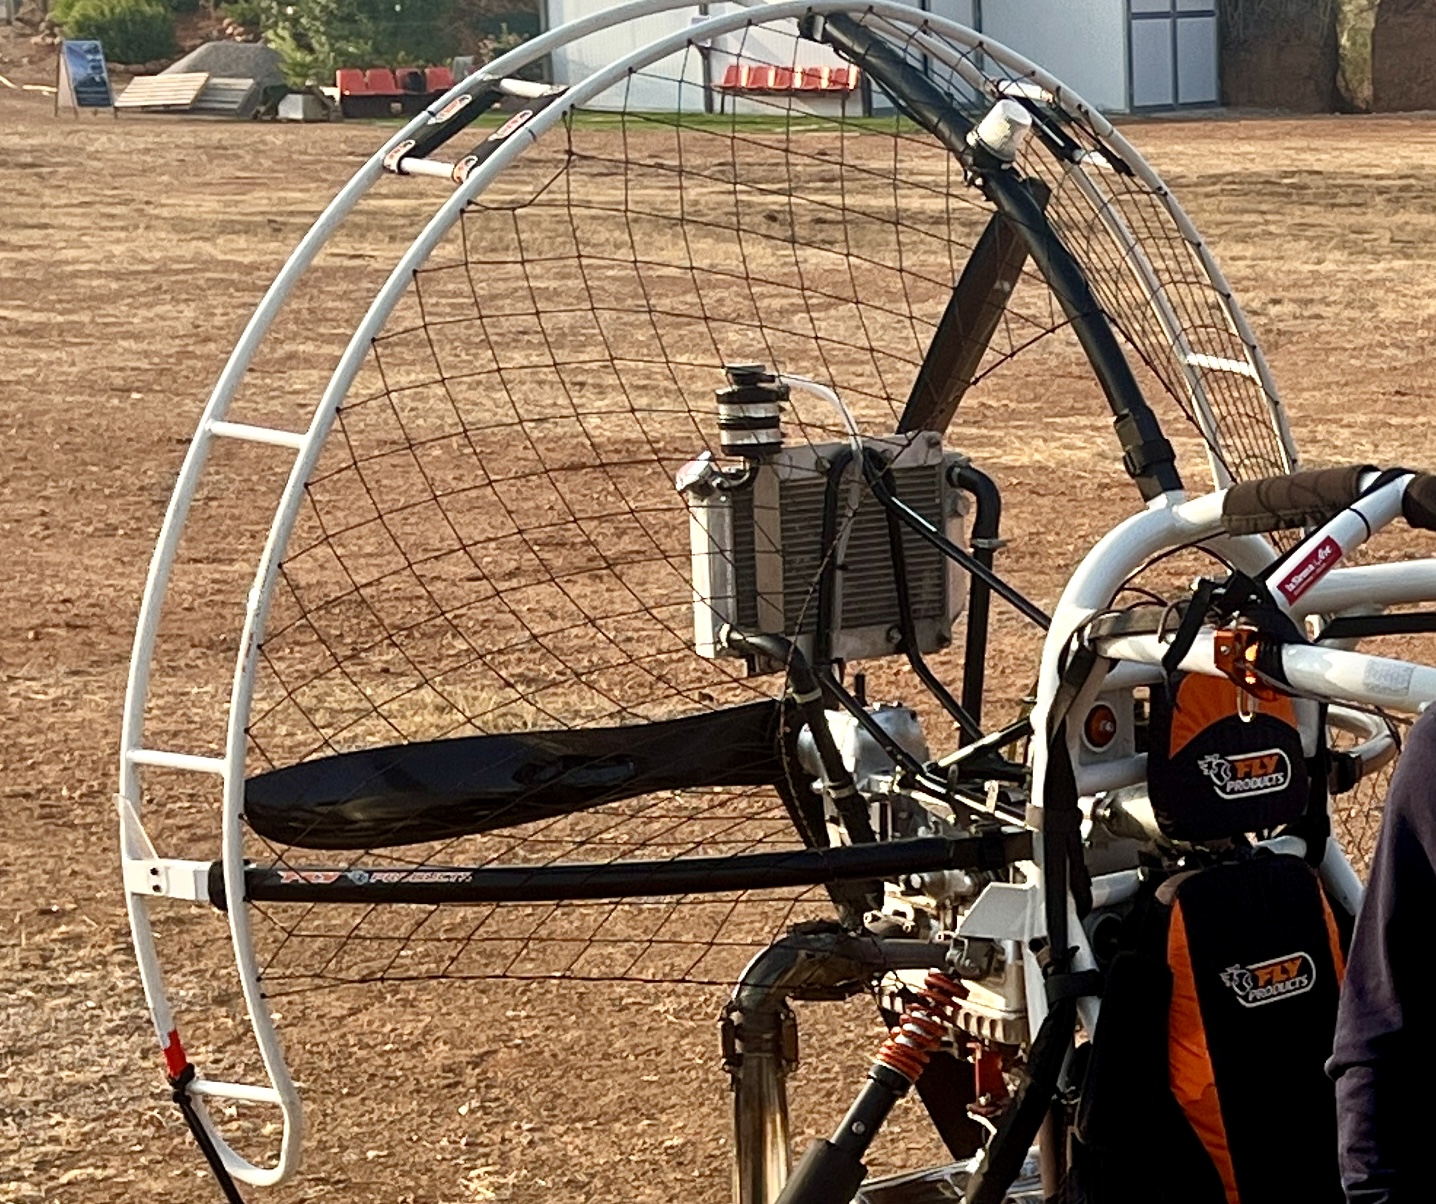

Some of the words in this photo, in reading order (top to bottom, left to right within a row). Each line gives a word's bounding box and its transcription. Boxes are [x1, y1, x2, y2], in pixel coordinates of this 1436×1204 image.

[1234, 755, 1279, 778] FLY
[1226, 772, 1284, 792] PRODUCTS
[1254, 957, 1303, 987] FLY
[1248, 974, 1308, 1001] PRODUCTS
